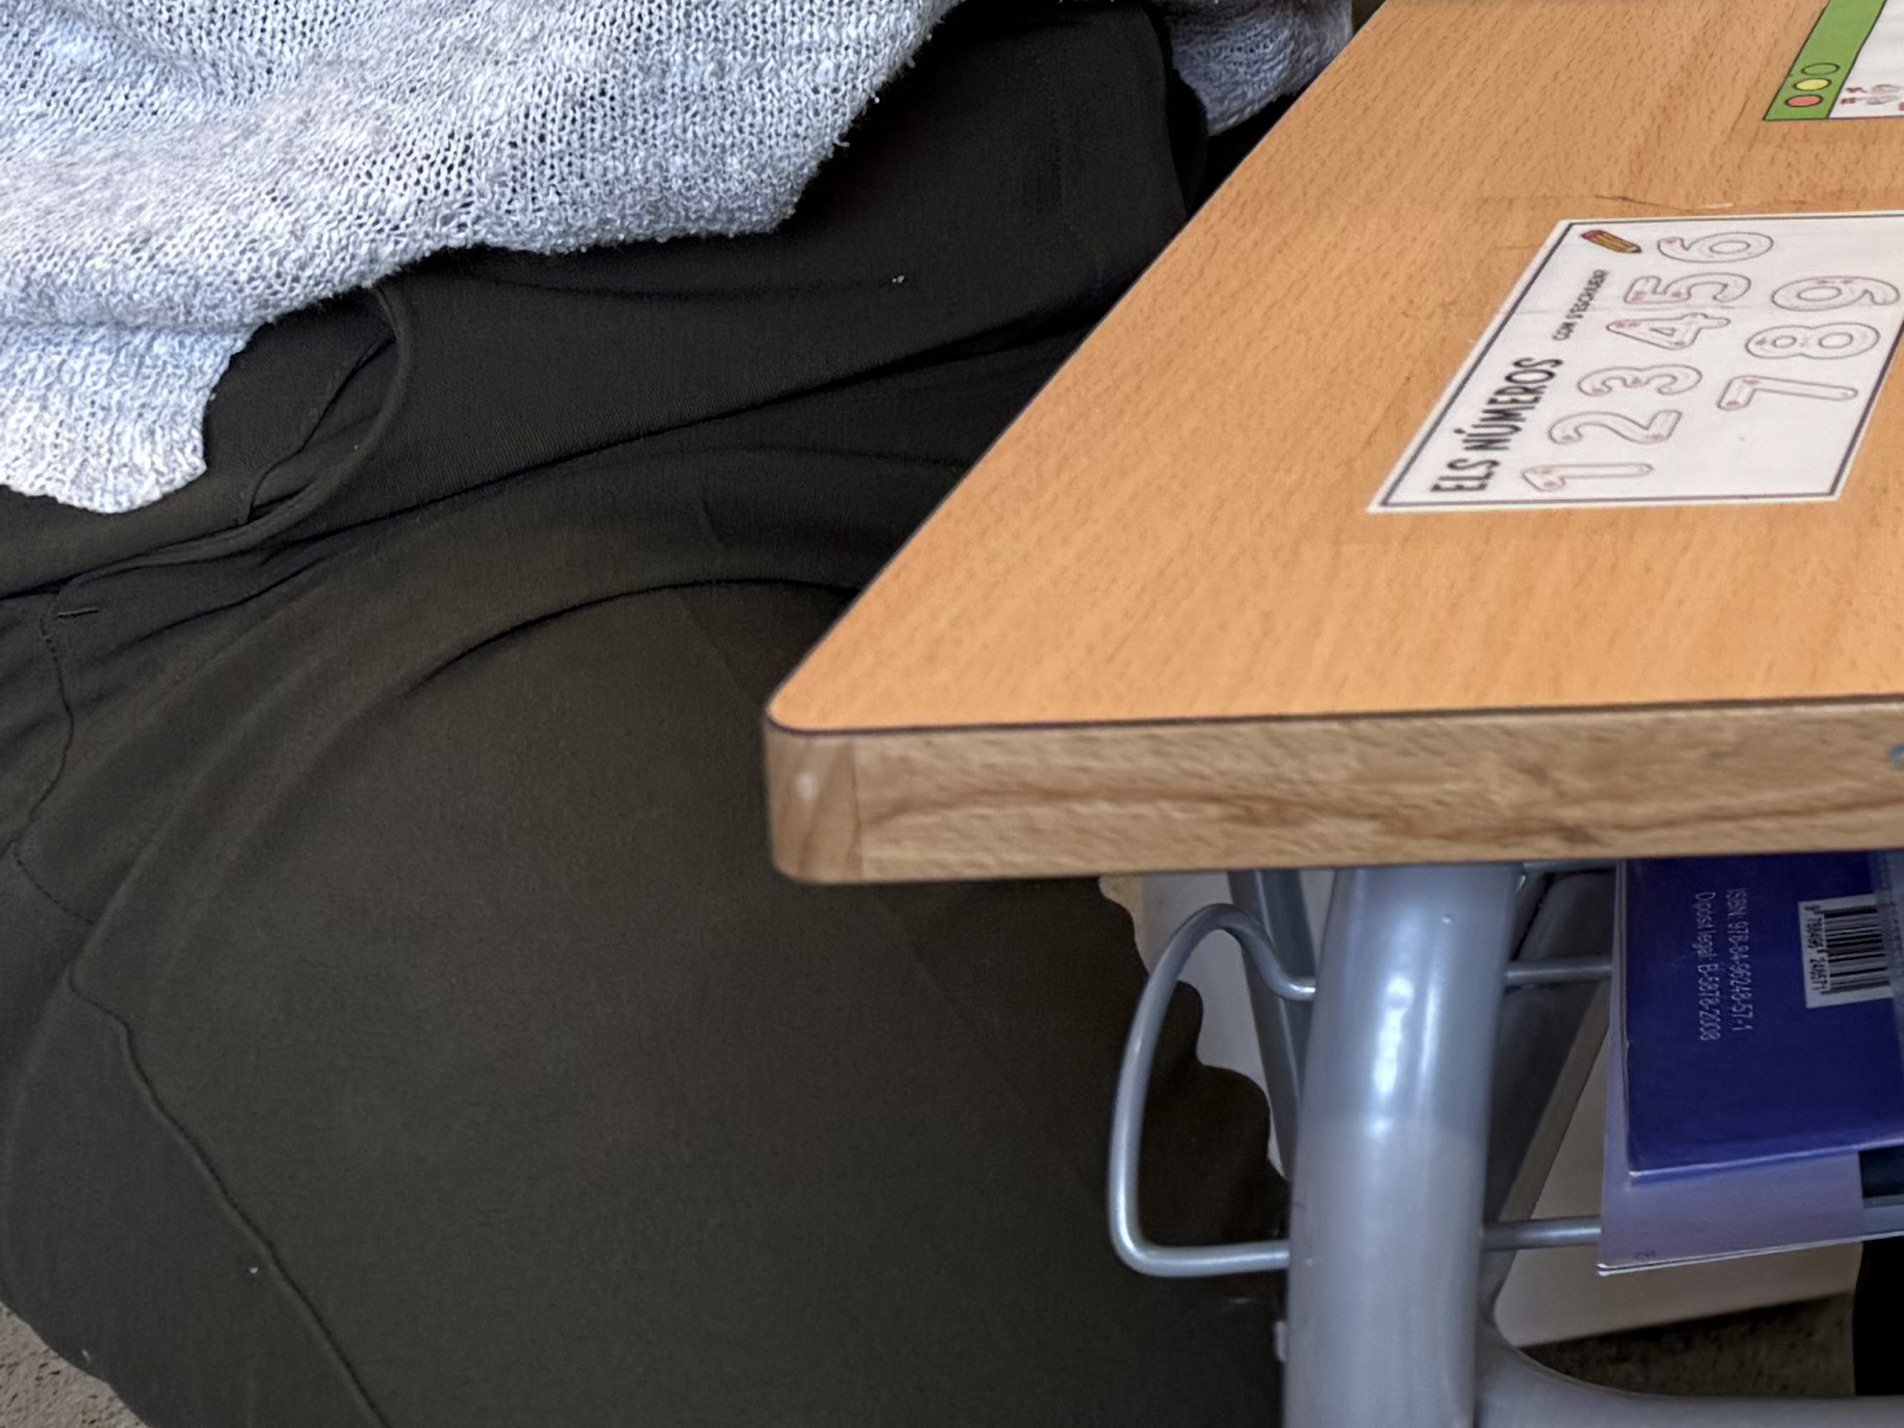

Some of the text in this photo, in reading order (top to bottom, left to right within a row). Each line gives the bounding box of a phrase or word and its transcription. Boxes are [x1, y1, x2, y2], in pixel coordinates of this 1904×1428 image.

[1522, 230, 1774, 493] 1 2 3 4 5 6
[1715, 274, 1901, 411] 7 8 9
[1430, 356, 1564, 493] ELS NÚMEROS
